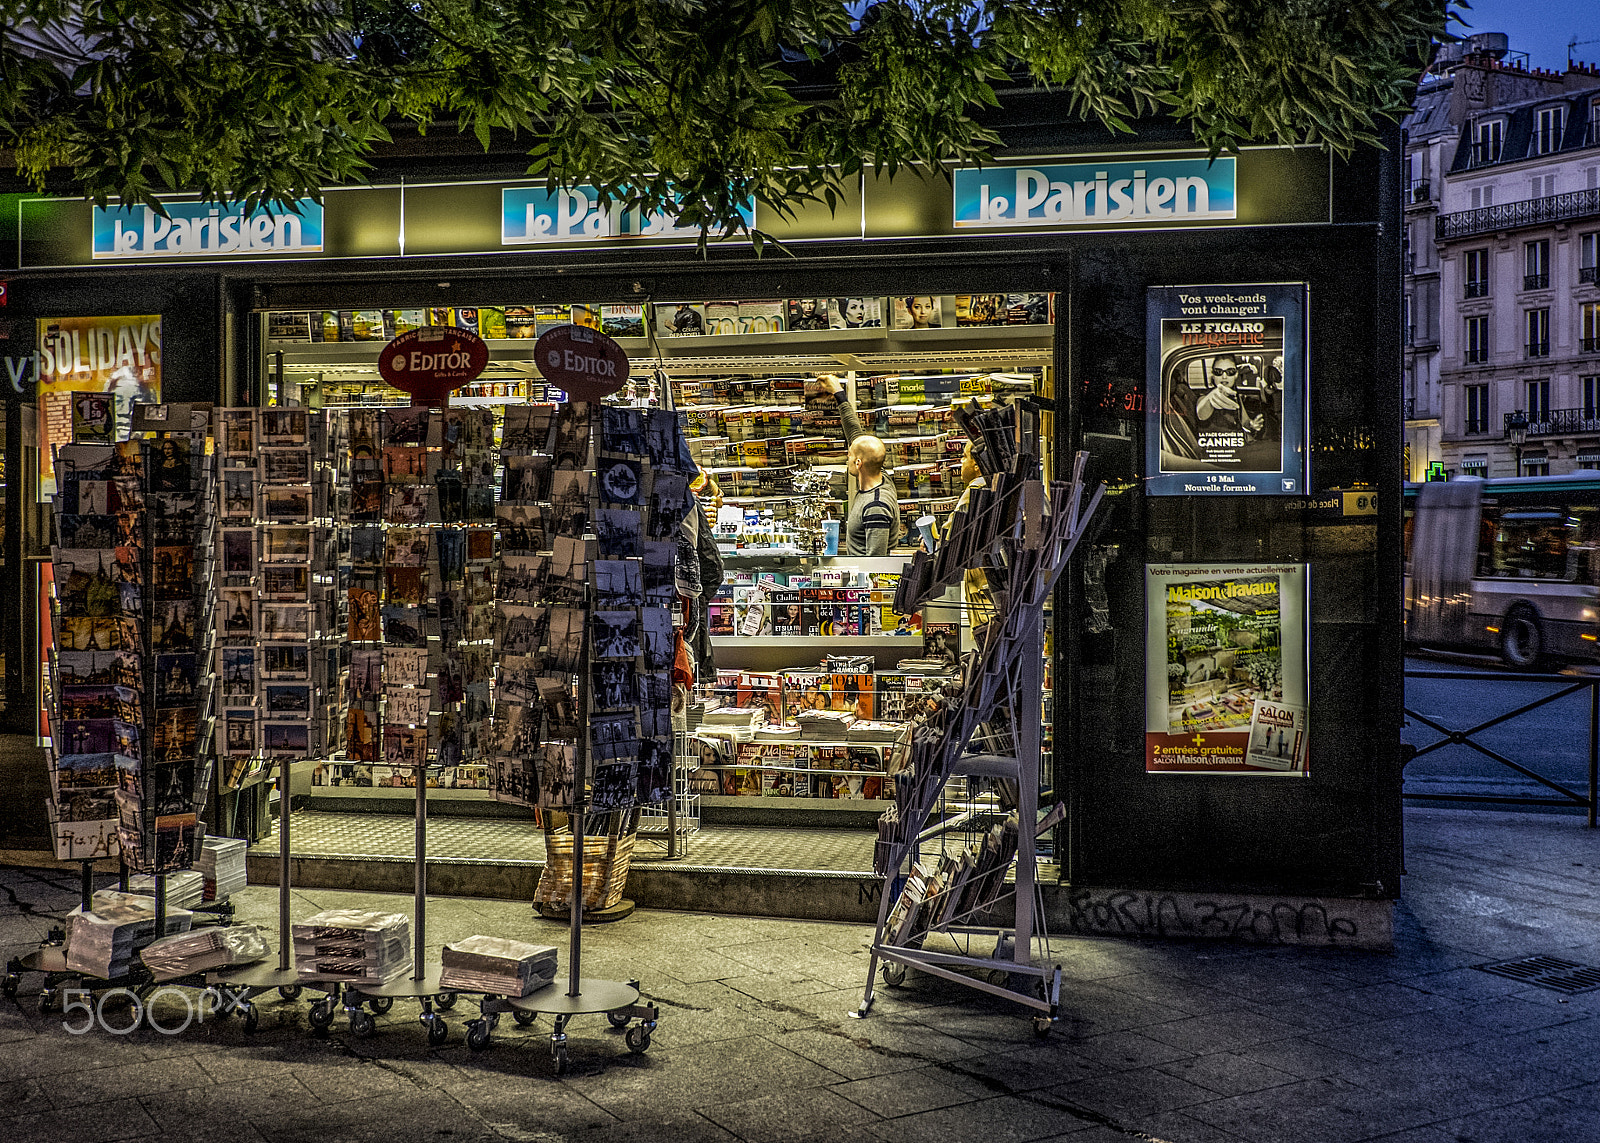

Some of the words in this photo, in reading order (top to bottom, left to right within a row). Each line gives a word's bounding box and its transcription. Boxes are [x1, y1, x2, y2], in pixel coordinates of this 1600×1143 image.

[979, 185, 1009, 224] le
[1015, 169, 1209, 223] Parisien
[525, 202, 552, 239] le
[113, 215, 138, 255] le
[143, 205, 301, 254] Parisien
[1179, 294, 1201, 304] Vos
[1205, 293, 1266, 304] week-ends
[1181, 305, 1207, 314] vont
[1211, 305, 1260, 316] changer
[1180, 324, 1201, 333] LE
[1204, 323, 1264, 333] FIGARO
[1182, 332, 1264, 348] magazine
[41, 321, 161, 375] SOLIDAYS
[409, 351, 471, 372] EDITOR
[564, 350, 616, 377] EDITOR
[1198, 437, 1245, 447] CANNES
[1219, 475, 1234, 483] Mai
[1184, 484, 1221, 492] Nouvelle
[1223, 484, 1256, 492] formule
[1150, 568, 1170, 576] Votre
[1172, 567, 1209, 577] magazine
[1246, 566, 1296, 574] actuellement
[740, 674, 779, 687] lui
[1259, 706, 1294, 721] SALON
[1153, 745, 1160, 755] 2
[1163, 745, 1198, 755] entrées
[1200, 745, 1243, 757] gratuites
